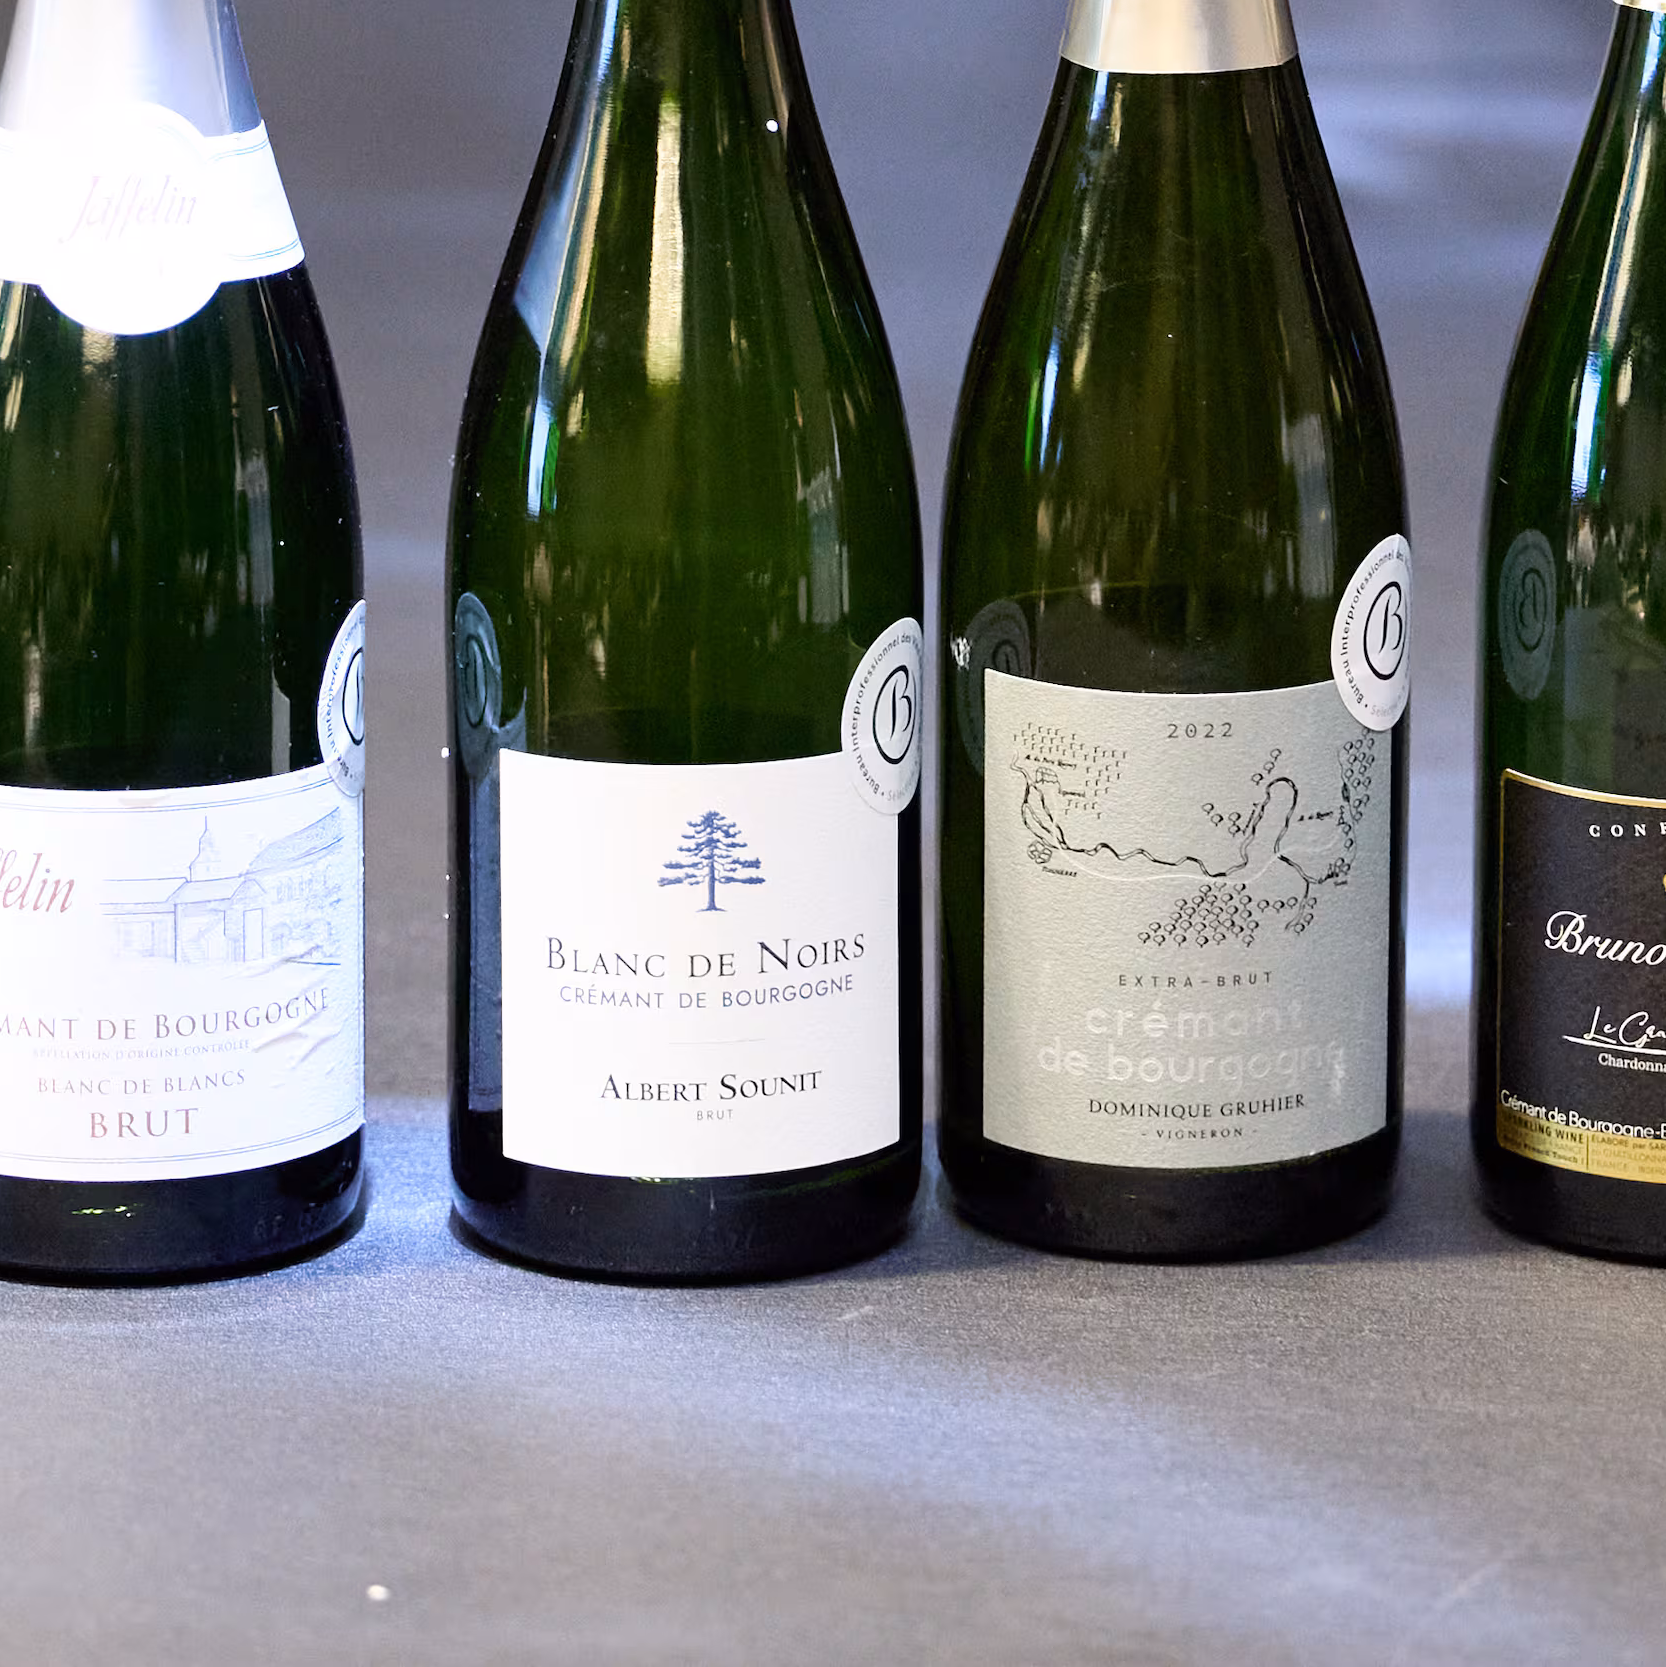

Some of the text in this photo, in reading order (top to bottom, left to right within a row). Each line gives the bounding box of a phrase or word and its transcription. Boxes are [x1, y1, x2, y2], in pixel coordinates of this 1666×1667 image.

[1340, 549, 1395, 656] Interprofessionnel
[850, 634, 900, 753] Interprofessionnel
[1342, 660, 1364, 704] Bureau
[1167, 722, 1234, 740] 2022
[856, 755, 881, 795] Bureau
[545, 934, 867, 979] BLANC DE NOIRS
[559, 974, 855, 1009] CRÉMANT DE BOURGOGNE
[1118, 971, 1275, 989] EXTRA-BRUT
[96, 1018, 137, 1041] DE
[154, 986, 330, 1040] BOURGOGNE
[1084, 1000, 1305, 1038] crémant
[1037, 1035, 1088, 1075] de
[37, 1069, 246, 1096] BLANC DE BLANCS
[599, 1070, 823, 1102] ALBERT SOUNIT
[89, 1107, 200, 1139] BRUT
[696, 1109, 735, 1122] BRUT
[1088, 1093, 1306, 1120] DOMINIQUE GRUHIER
[1501, 1089, 1547, 1121] Crémant
[1548, 1106, 1566, 1124] de
[1155, 1128, 1245, 1141] VIGNERON
[1555, 1128, 1584, 1145] WINE
